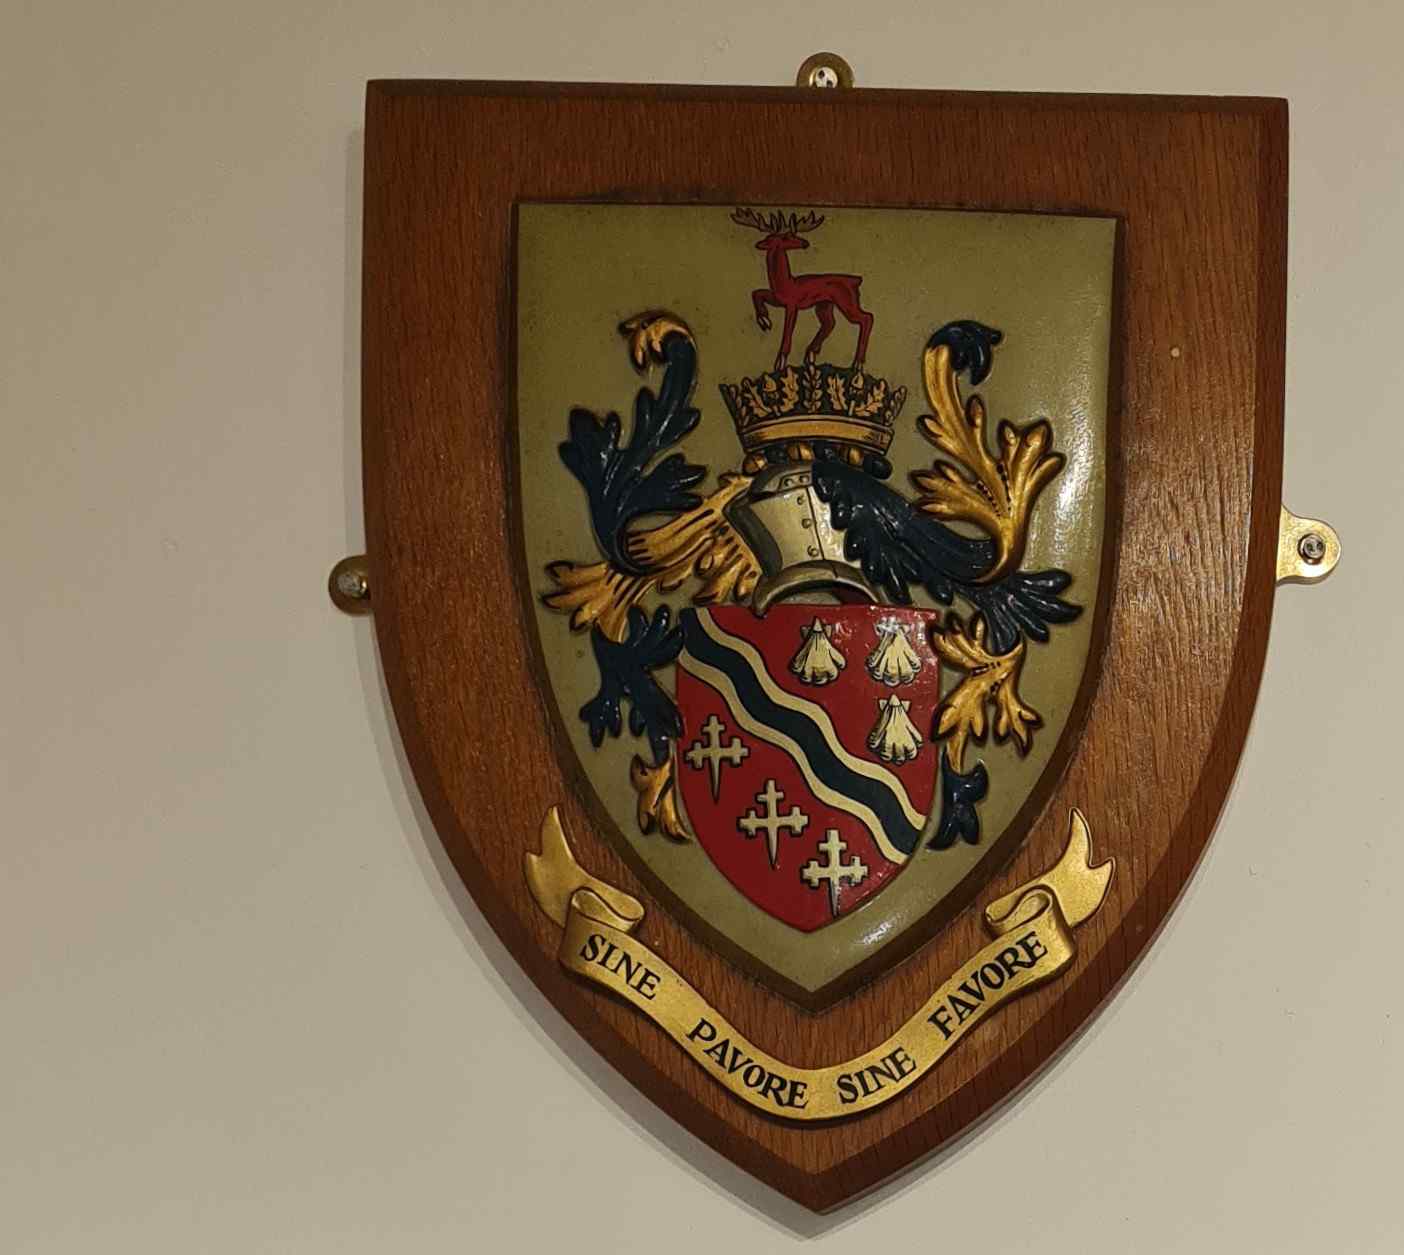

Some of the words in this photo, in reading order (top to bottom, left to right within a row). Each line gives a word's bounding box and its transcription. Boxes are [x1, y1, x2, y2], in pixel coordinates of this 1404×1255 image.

[580, 934, 661, 1000] SINE
[687, 1019, 809, 1110] PAVORE
[837, 1048, 917, 1104] SINE
[928, 931, 1048, 1040] FAVORE
